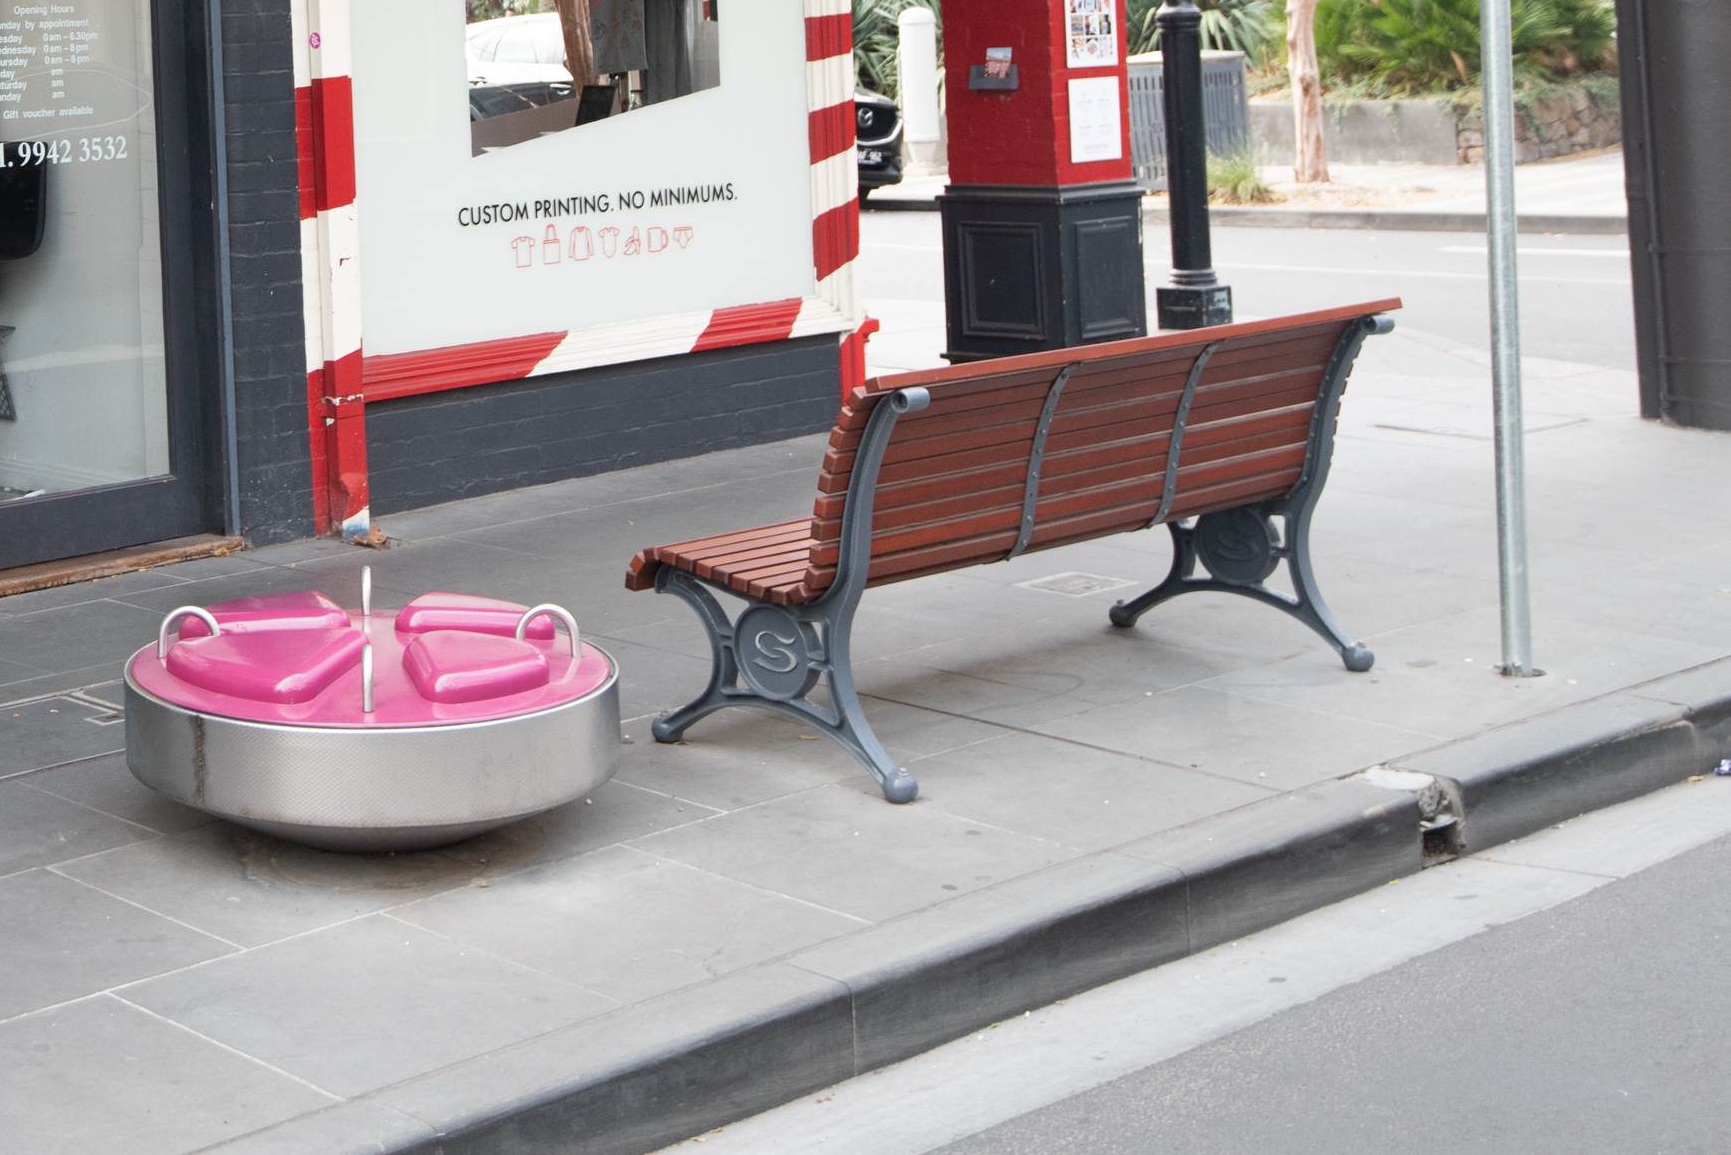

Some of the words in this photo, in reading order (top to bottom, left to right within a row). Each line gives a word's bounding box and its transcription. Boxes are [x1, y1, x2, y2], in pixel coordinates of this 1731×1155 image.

[13, 5, 48, 16] Opening
[50, 5, 75, 14] Hours
[25, 20, 35, 30] by
[38, 18, 89, 30] appointment
[3, 110, 19, 120] Gift
[23, 108, 56, 119] voucher
[59, 106, 94, 117] available
[18, 139, 73, 167] 9942
[78, 136, 128, 162] 3532
[458, 202, 529, 227] CUSTOM
[534, 194, 614, 219] PRINTING.
[619, 190, 645, 211] NO
[650, 182, 738, 208] MINIMUMS.
